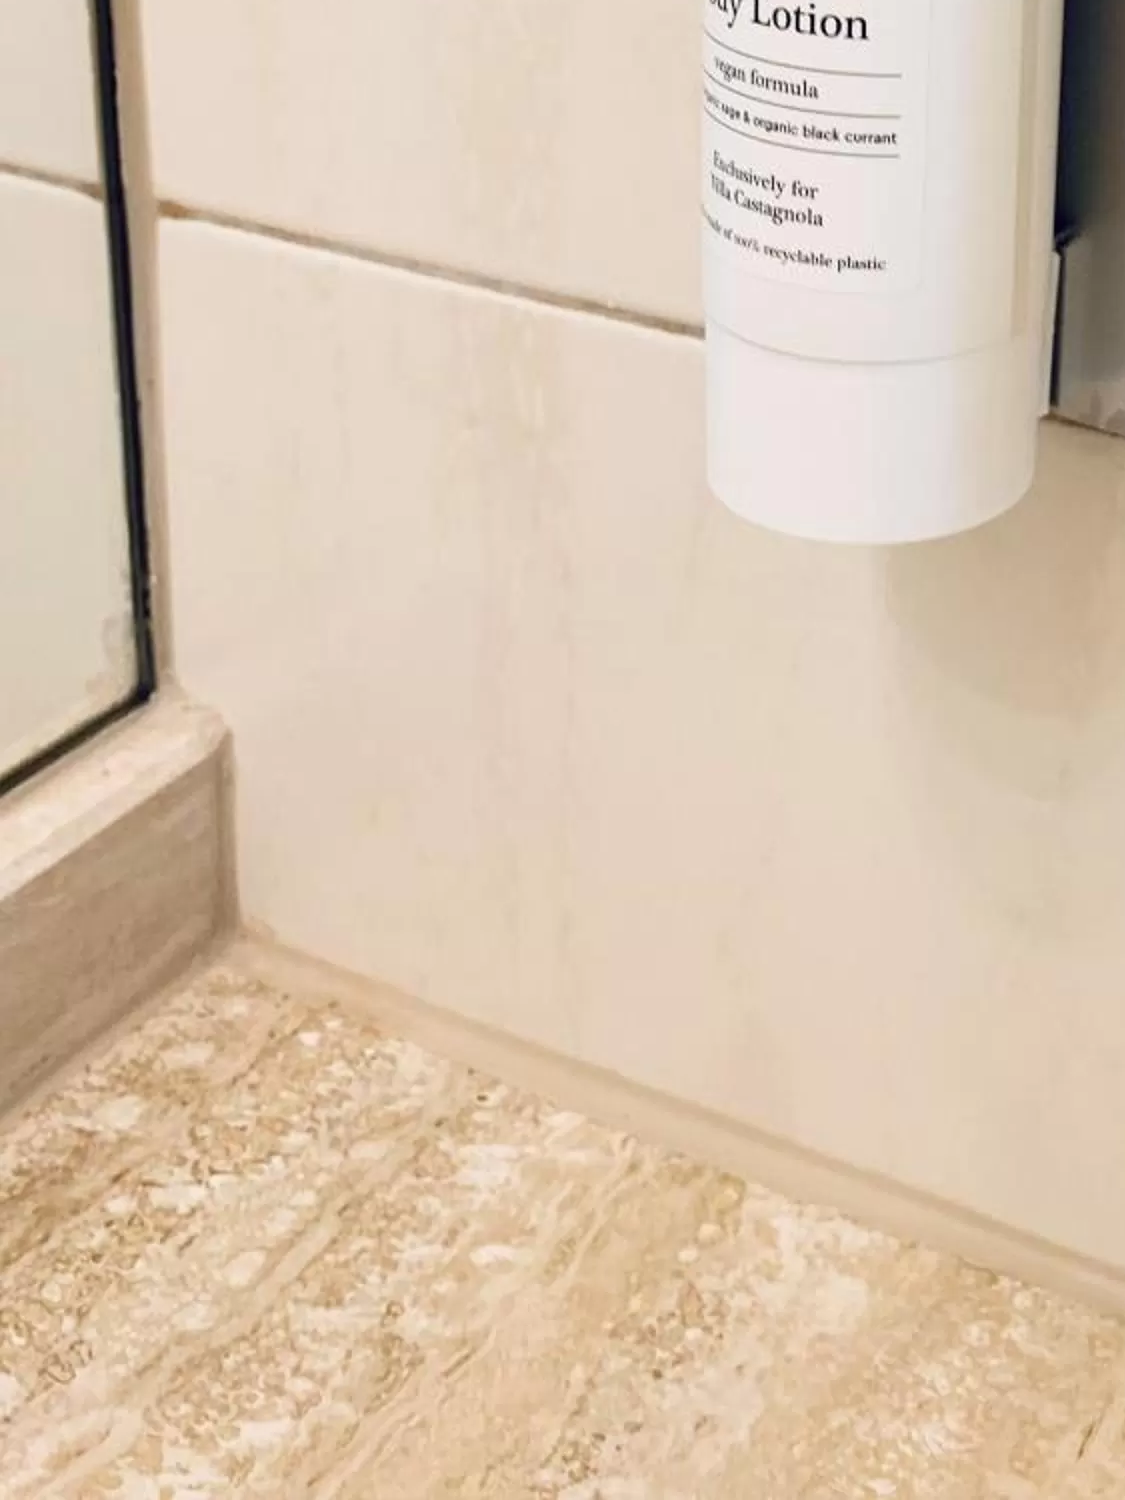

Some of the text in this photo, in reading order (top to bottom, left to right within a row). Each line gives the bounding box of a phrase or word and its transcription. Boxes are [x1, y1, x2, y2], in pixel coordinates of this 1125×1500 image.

[713, 56, 746, 83] vegan
[751, 68, 819, 99] formula
[753, 116, 798, 137] organic
[803, 124, 840, 142] black
[844, 132, 897, 146] currant
[713, 149, 820, 200] Exclusively for
[734, 188, 824, 227] Castagnola
[763, 244, 833, 269] recyclable
[837, 256, 887, 273] plastic
